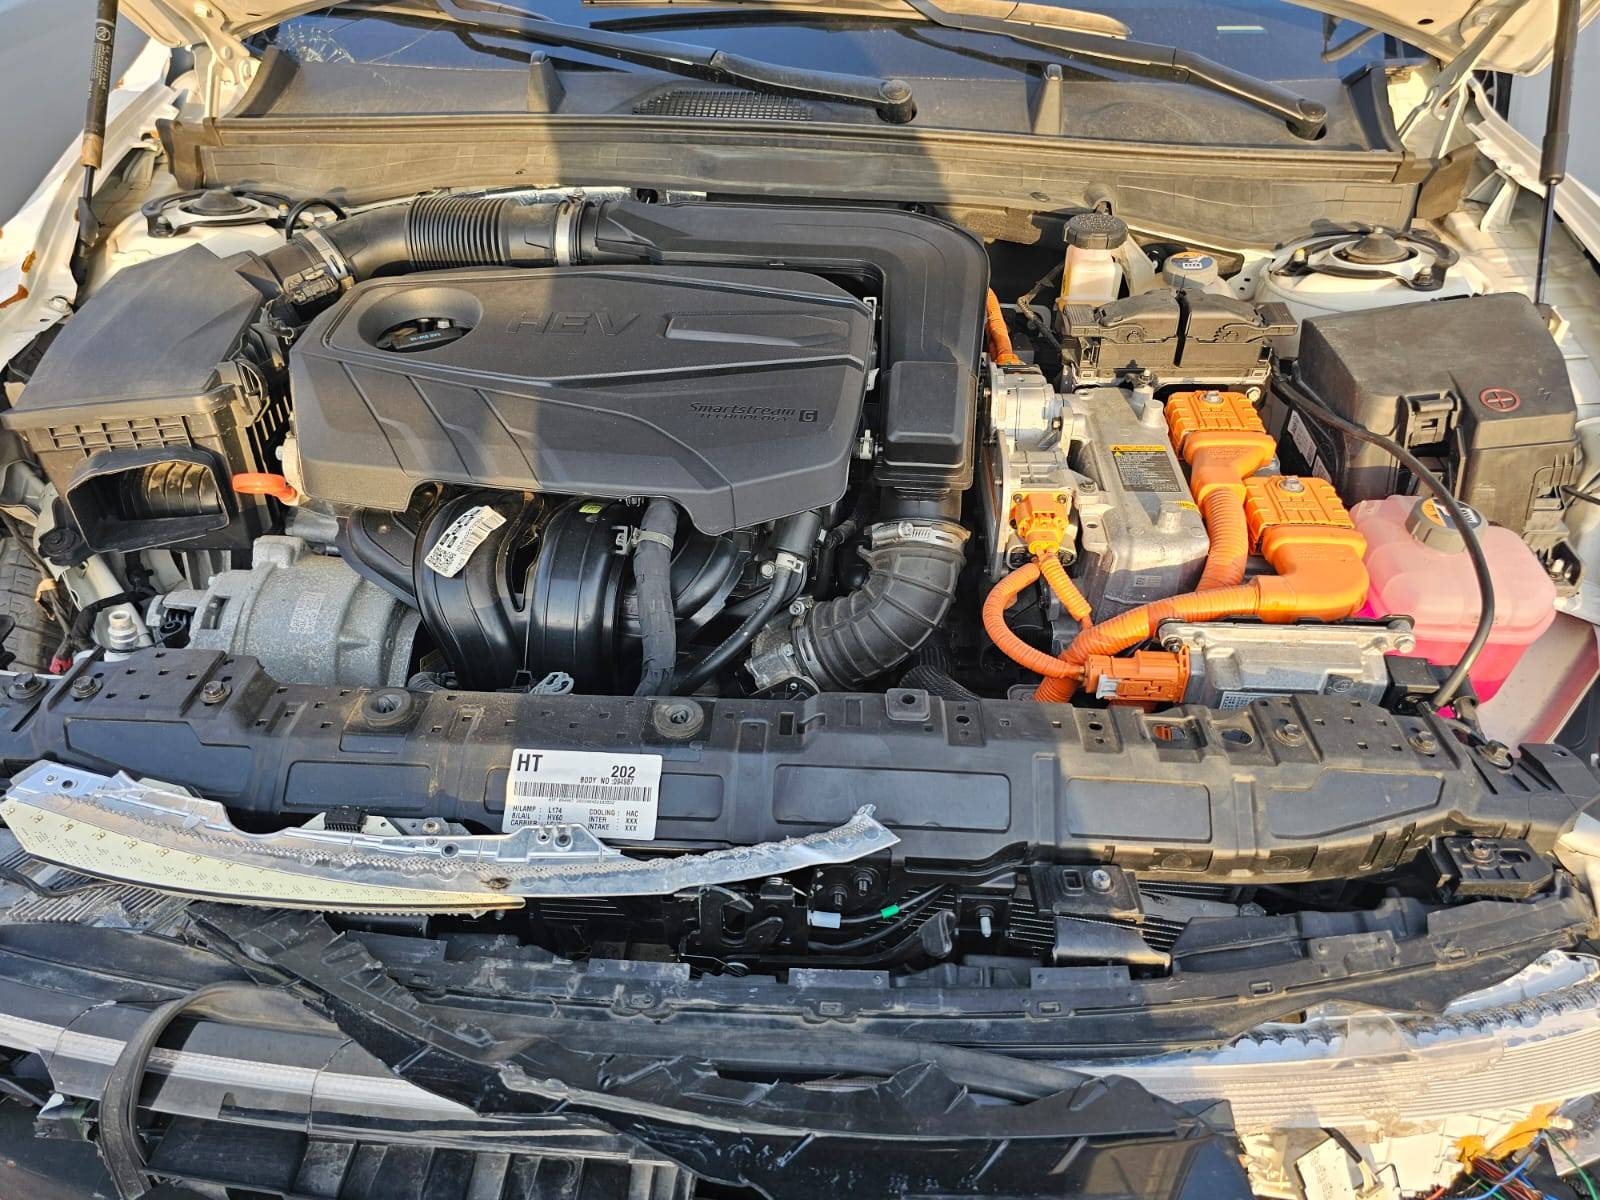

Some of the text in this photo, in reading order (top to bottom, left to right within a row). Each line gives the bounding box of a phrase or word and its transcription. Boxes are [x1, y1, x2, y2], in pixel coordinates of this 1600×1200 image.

[504, 311, 640, 336] HEV
[690, 402, 795, 416] Smartstream
[799, 410, 818, 422] G
[517, 754, 543, 772] HT
[611, 766, 636, 778] 202
[580, 776, 597, 784] BODY
[600, 777, 610, 785] NO
[589, 808, 616, 816] COOLING
[588, 815, 607, 823] INTER
[588, 823, 610, 831] INTAKE
